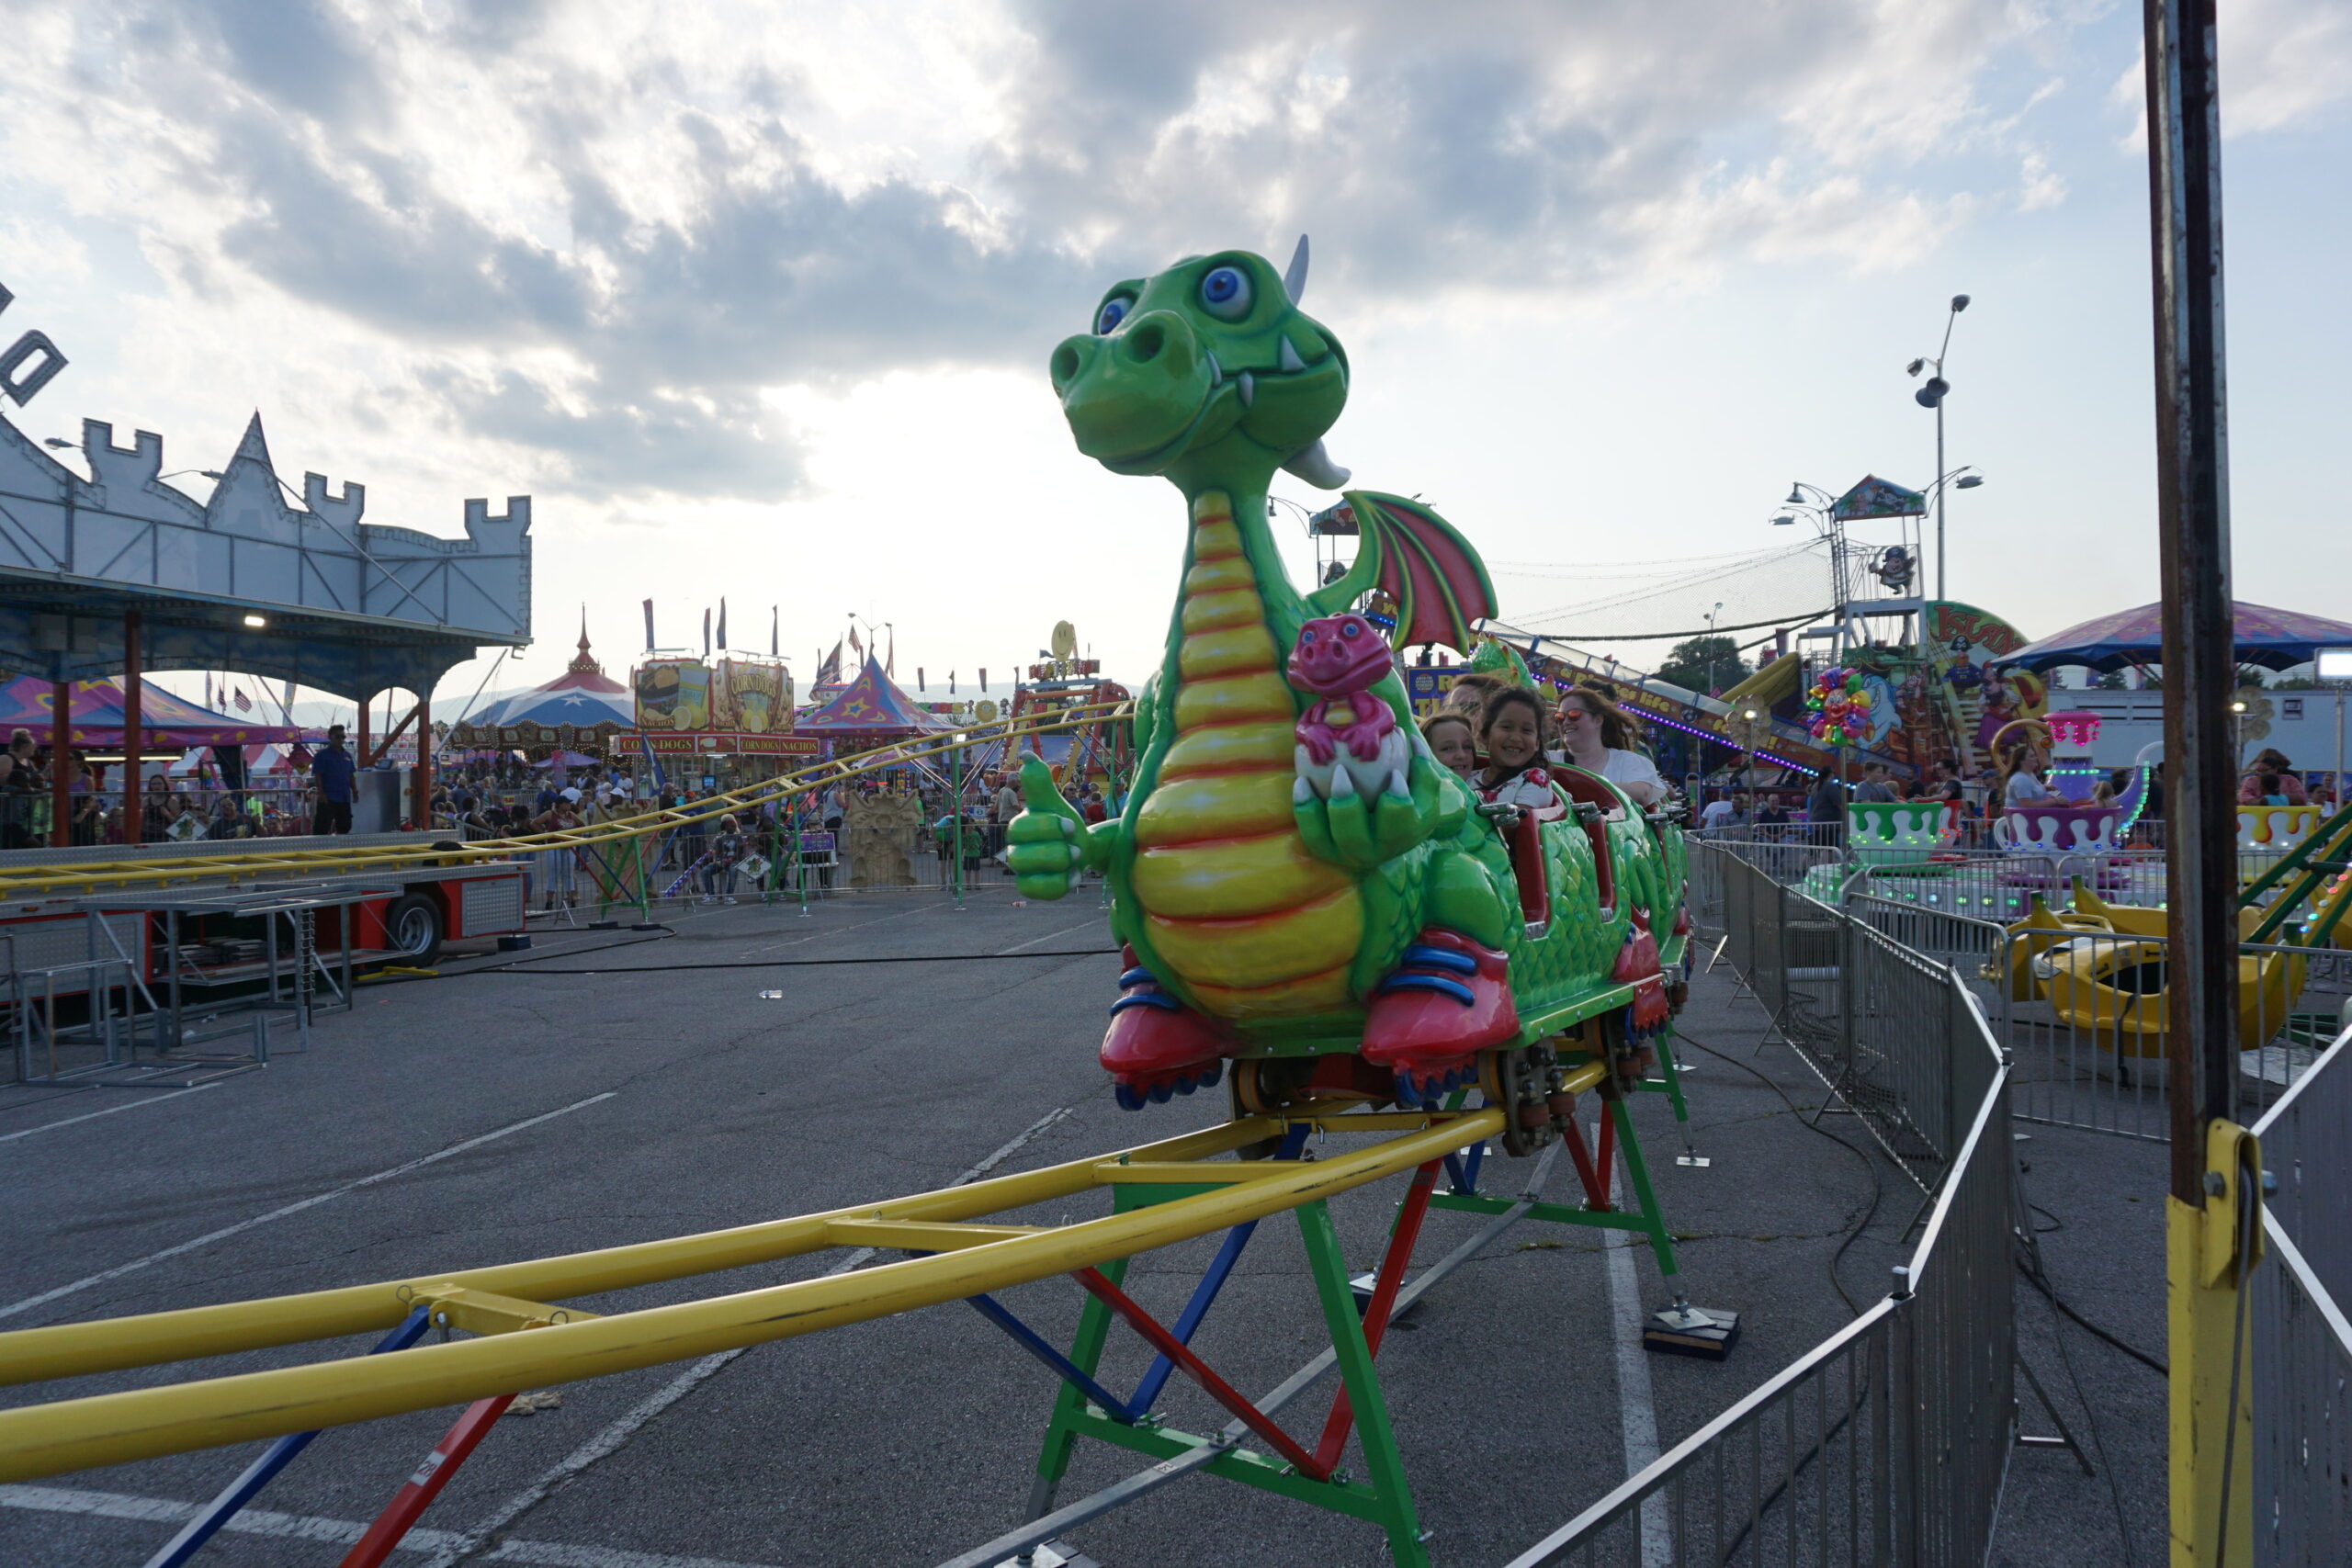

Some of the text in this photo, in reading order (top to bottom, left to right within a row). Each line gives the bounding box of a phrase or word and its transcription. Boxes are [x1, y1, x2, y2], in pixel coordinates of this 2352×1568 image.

[730, 674, 777, 697] CORN DOGS
[1574, 671, 1637, 701] ptes
[1639, 691, 1670, 713] life
[641, 715, 675, 728] NACHOS
[622, 739, 692, 750] CON DOGS
[741, 740, 779, 751] CORN DOGS
[782, 741, 817, 751] NACHOS
